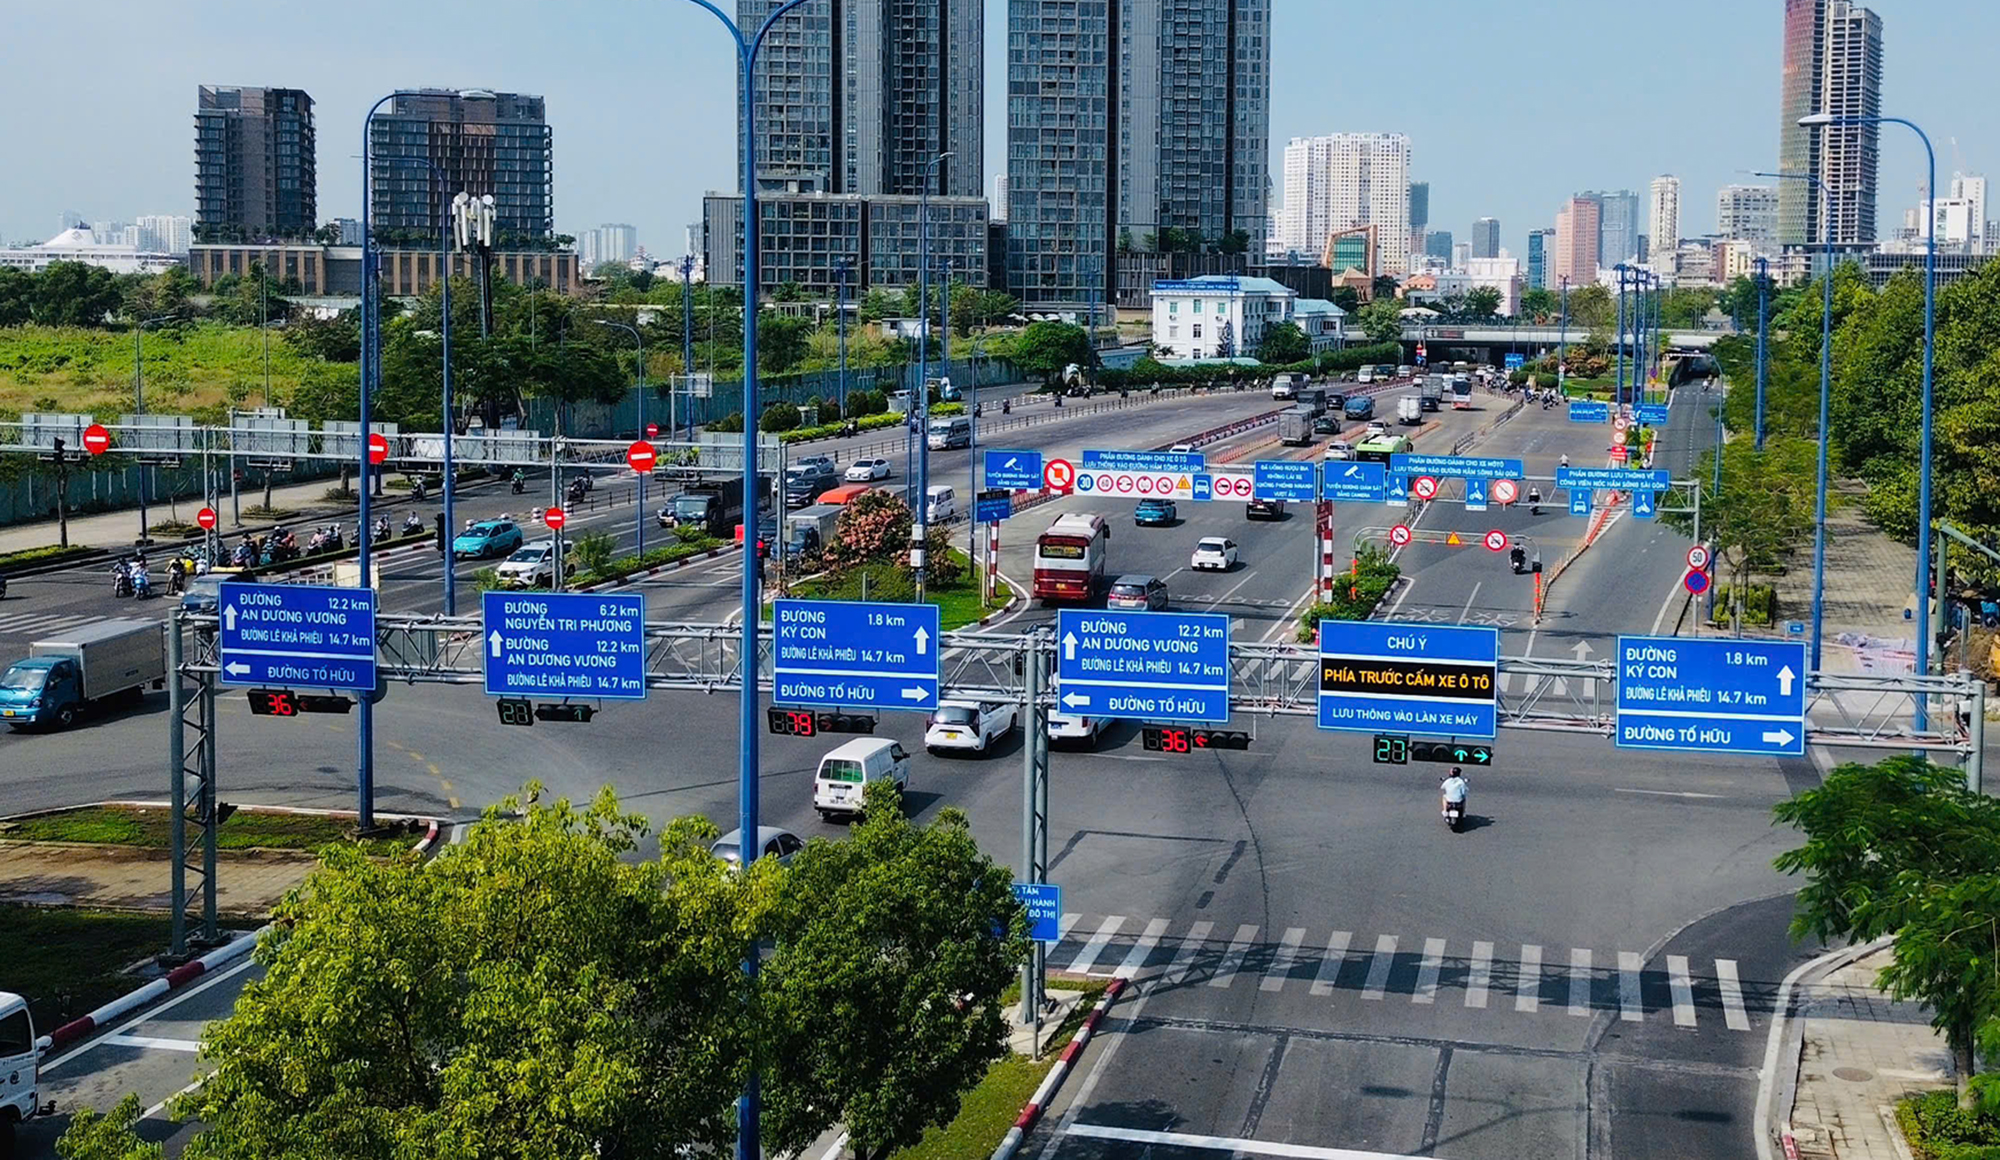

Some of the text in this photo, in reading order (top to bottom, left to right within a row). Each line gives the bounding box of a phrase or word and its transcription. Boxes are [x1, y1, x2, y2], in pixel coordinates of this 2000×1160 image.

[1080, 477, 1090, 488] 30
[240, 591, 369, 610] ĐƯỜNG 12.2 km
[505, 600, 638, 617] ĐƯỜNG 6.2 km
[241, 609, 346, 625] AN DƯƠNG VƯƠNG
[505, 615, 632, 632] NGUYỄN TRI PHƯƠNG
[781, 607, 905, 626] ĐƯỜNG 1.8 km
[241, 627, 369, 646] ĐƯỜNG LÊ KHẢ PHIÊU 14.7 km
[781, 624, 825, 639] KÝ CON
[1081, 618, 1223, 638] ĐƯỜNG 12.2 km
[506, 636, 639, 653] ĐƯỜNG 12.2 km
[1082, 638, 1198, 653] AN DƯƠNG VƯƠNG
[1387, 635, 1427, 650] CHÚ Ý
[508, 654, 616, 667] AN DƯƠNG VƯƠNG
[782, 645, 905, 663] ĐƯỜNG LÊ KHẢ PHIÊU 14.7 km
[1626, 646, 1767, 665] ĐƯỜNG 1.8 km
[268, 663, 355, 682] ĐƯỜNG TỐ HỮU
[1082, 656, 1223, 675] ĐƯỜNG LÊ KHẢ PHIÊU 14.7 km
[1626, 662, 1677, 678] KÝ CON
[508, 672, 640, 689] ĐƯỜNG LÊ KHẢ PHIÊU 14.7 km
[1325, 667, 1489, 689] PHÍA TRƯỚC CẤM XE Ô TÔ
[781, 682, 874, 700] ĐƯỜNG TỐ HỮU
[1626, 685, 1766, 704] ĐƯỜNG LÊ KHẢ PHIÊU 14.7 km
[268, 694, 292, 715] 36
[1109, 695, 1205, 714] ĐƯỜNG TỐ HỮU
[787, 713, 811, 735] 79
[1333, 708, 1478, 725] LƯU THÔNG VÀO LÀN XE MÁY
[1162, 730, 1187, 752] 36
[1625, 725, 1730, 743] ĐƯỜNG TỐ HỮU
[1377, 739, 1405, 761] 27
